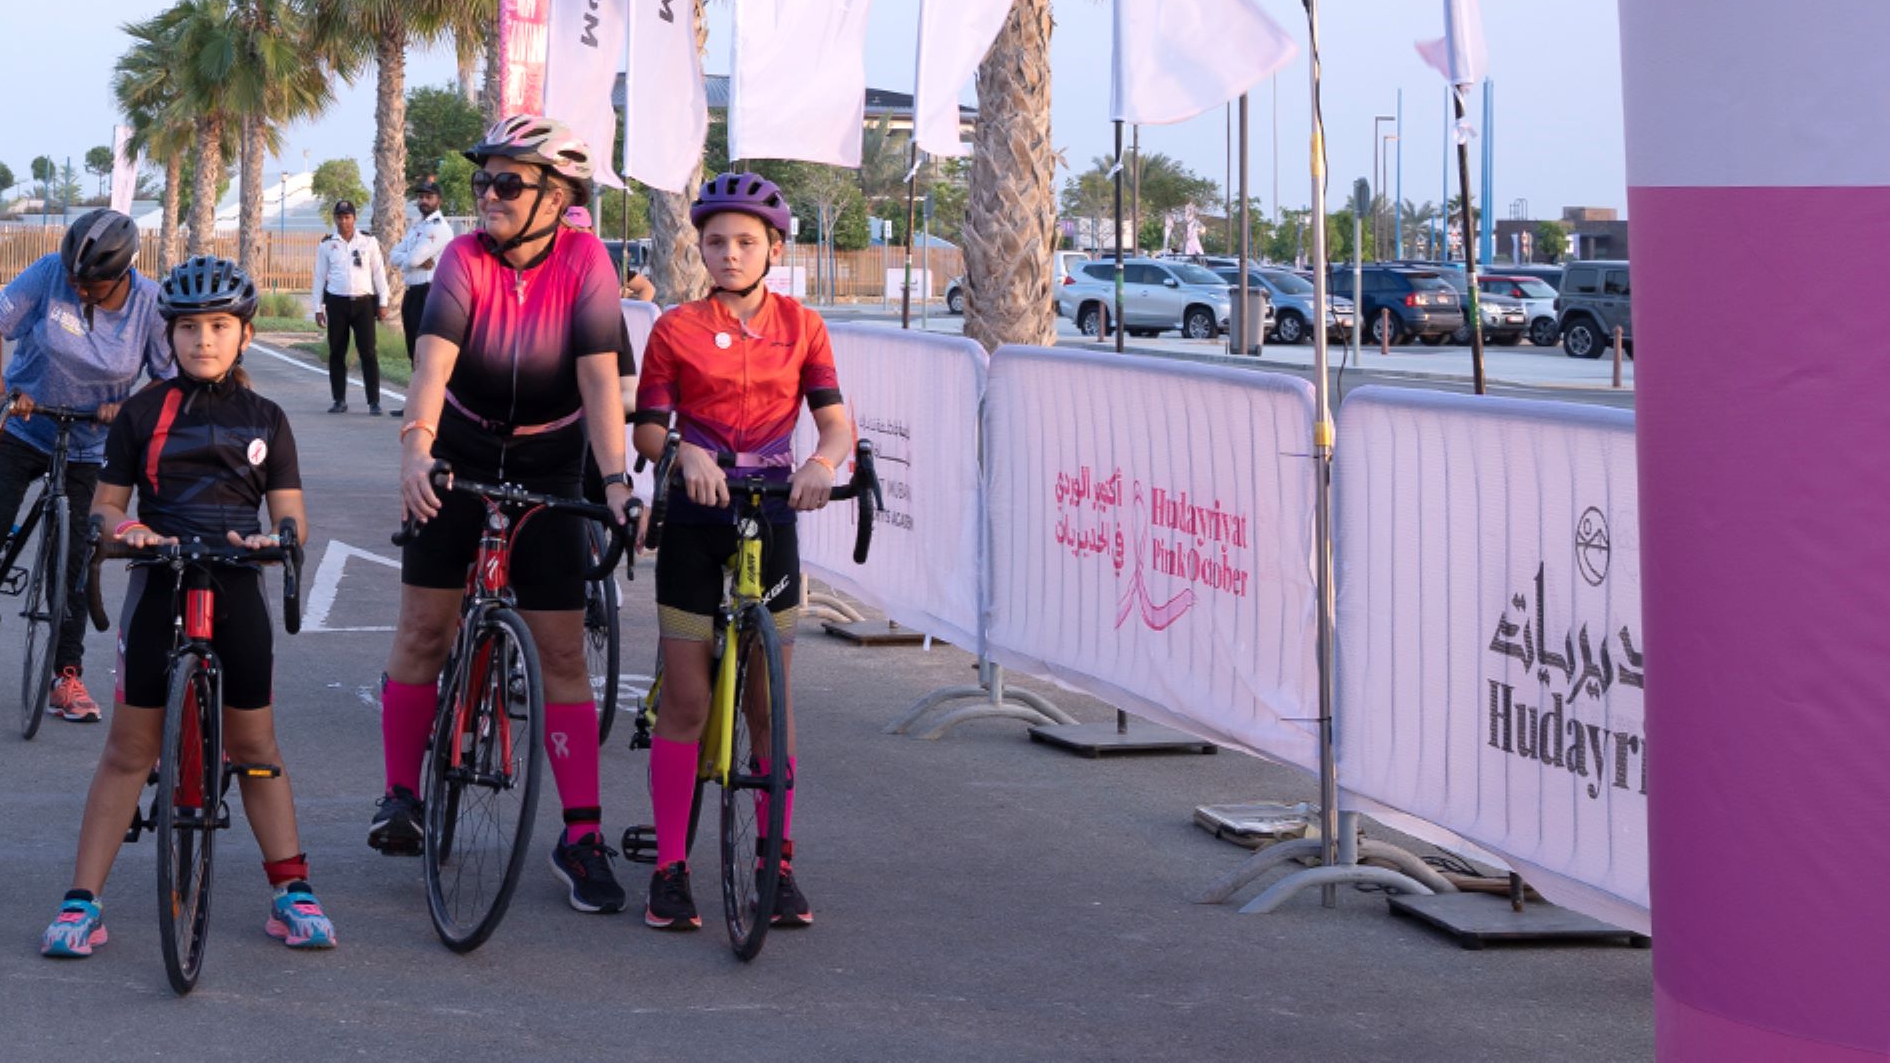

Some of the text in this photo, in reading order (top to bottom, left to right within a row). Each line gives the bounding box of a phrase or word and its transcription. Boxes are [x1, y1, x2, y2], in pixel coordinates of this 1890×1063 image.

[1151, 487, 1247, 549] Hudayriyat
[1112, 521, 1124, 578] في
[1152, 537, 1248, 597] Pink October
[1487, 678, 1648, 799] Hudayr
